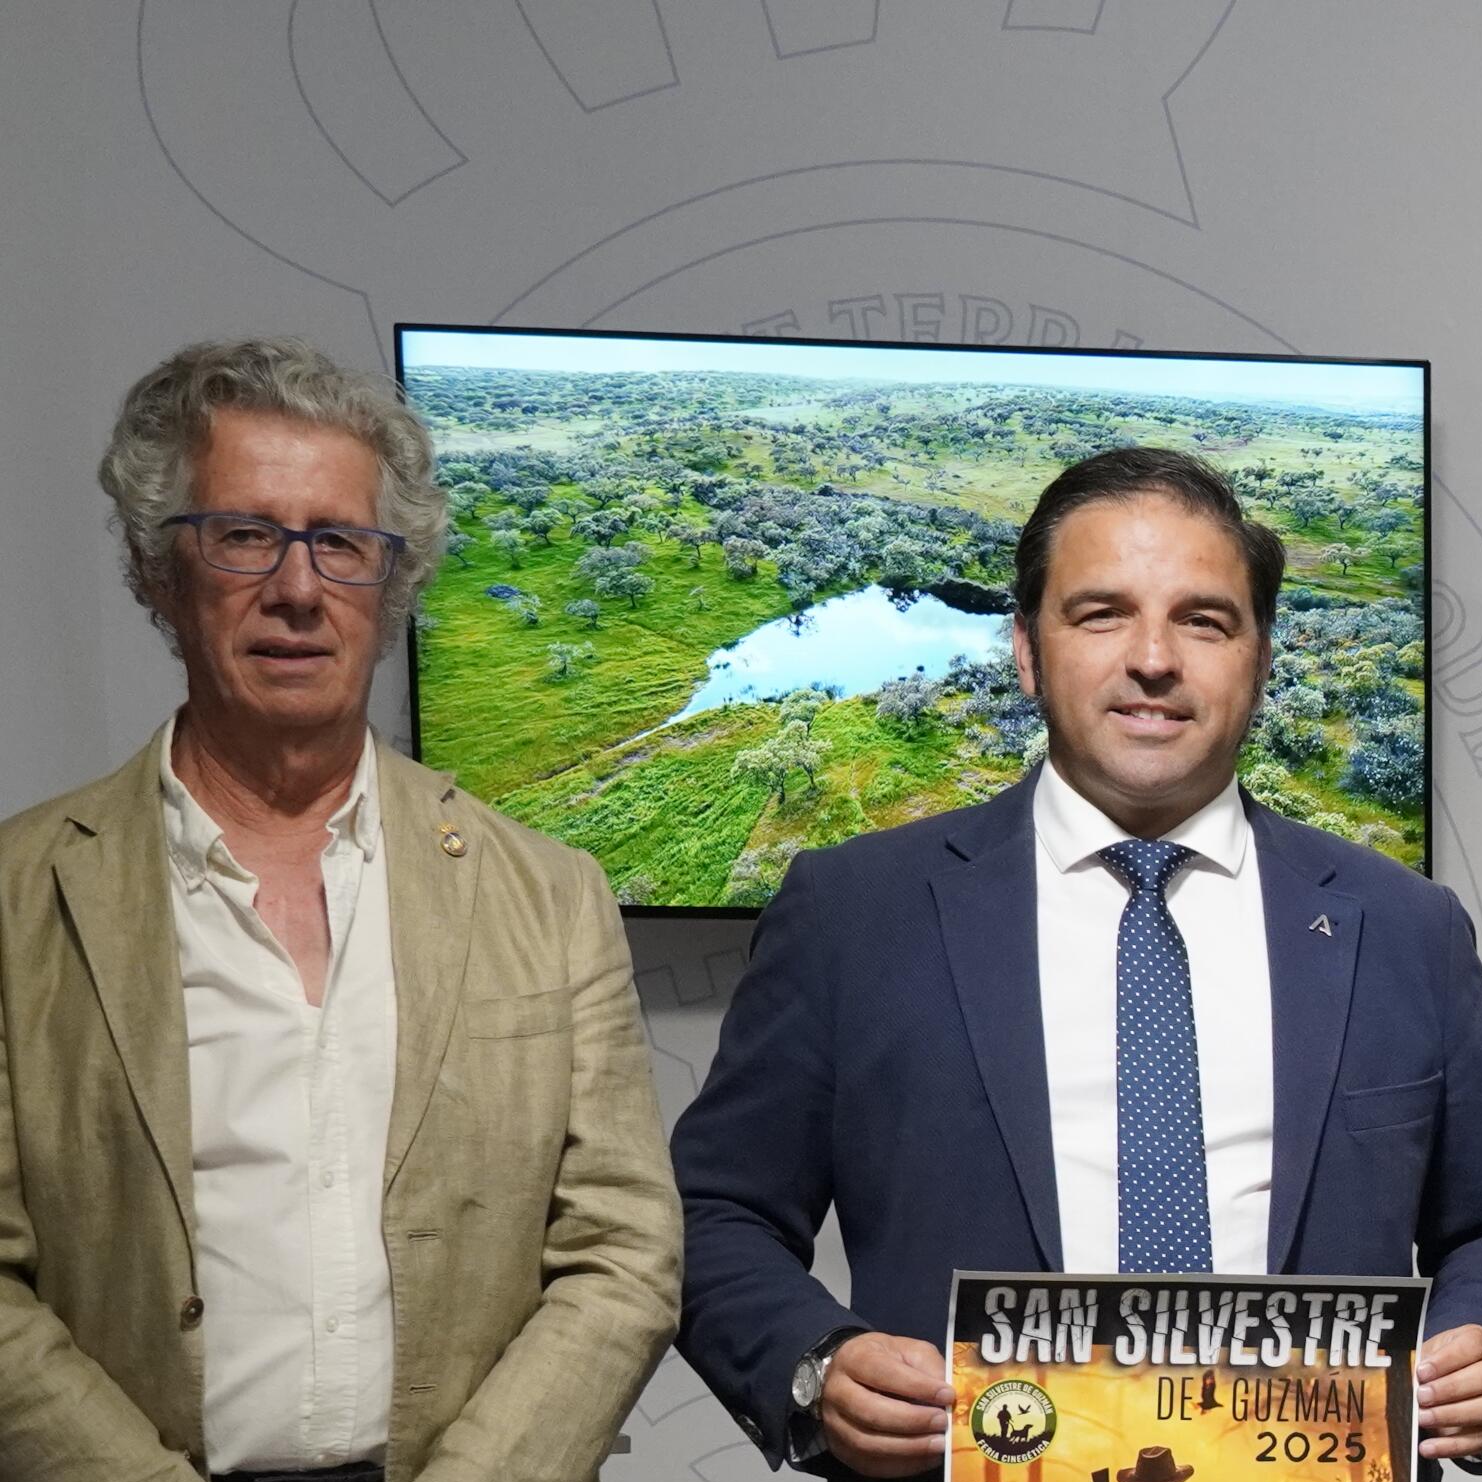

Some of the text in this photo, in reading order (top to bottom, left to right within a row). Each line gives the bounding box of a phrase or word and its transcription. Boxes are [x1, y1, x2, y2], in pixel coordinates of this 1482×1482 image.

[980, 1285, 1400, 1370] SAN SILVESTRE
[976, 1382, 1033, 1411] SAN SILVESTRE DE
[1156, 1373, 1366, 1424] DE GUZMÁN
[977, 1438, 1000, 1460] FERIA
[1255, 1430, 1367, 1464] 2025
